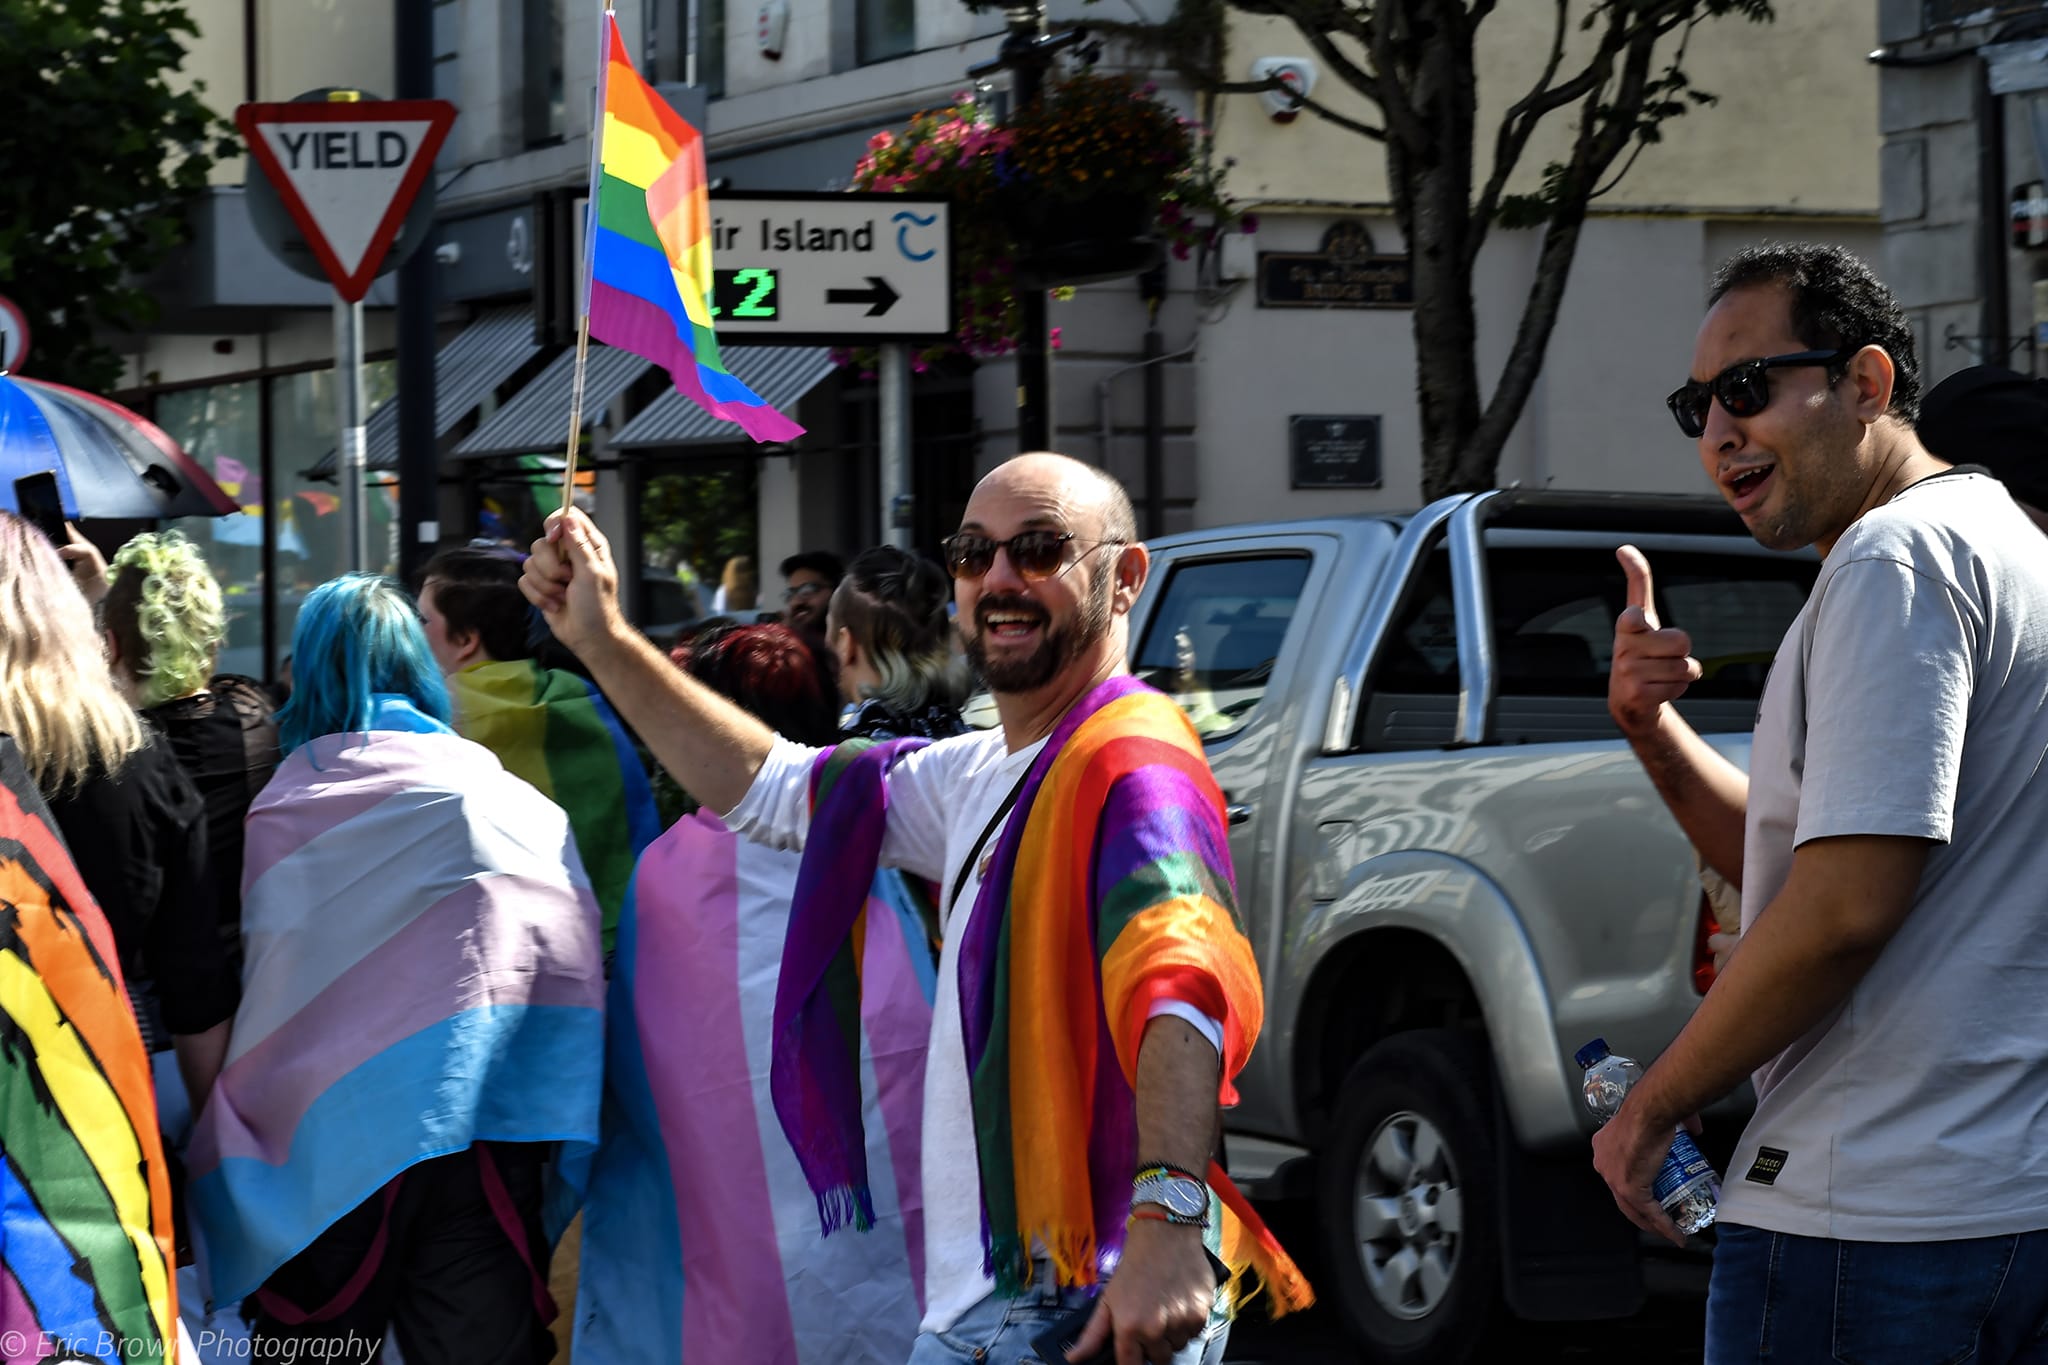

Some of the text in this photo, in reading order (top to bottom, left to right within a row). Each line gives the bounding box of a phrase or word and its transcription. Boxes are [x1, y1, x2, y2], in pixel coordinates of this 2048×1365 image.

[278, 130, 408, 170] YIELD
[713, 217, 874, 251] ir Island
[711, 268, 776, 317] 2
